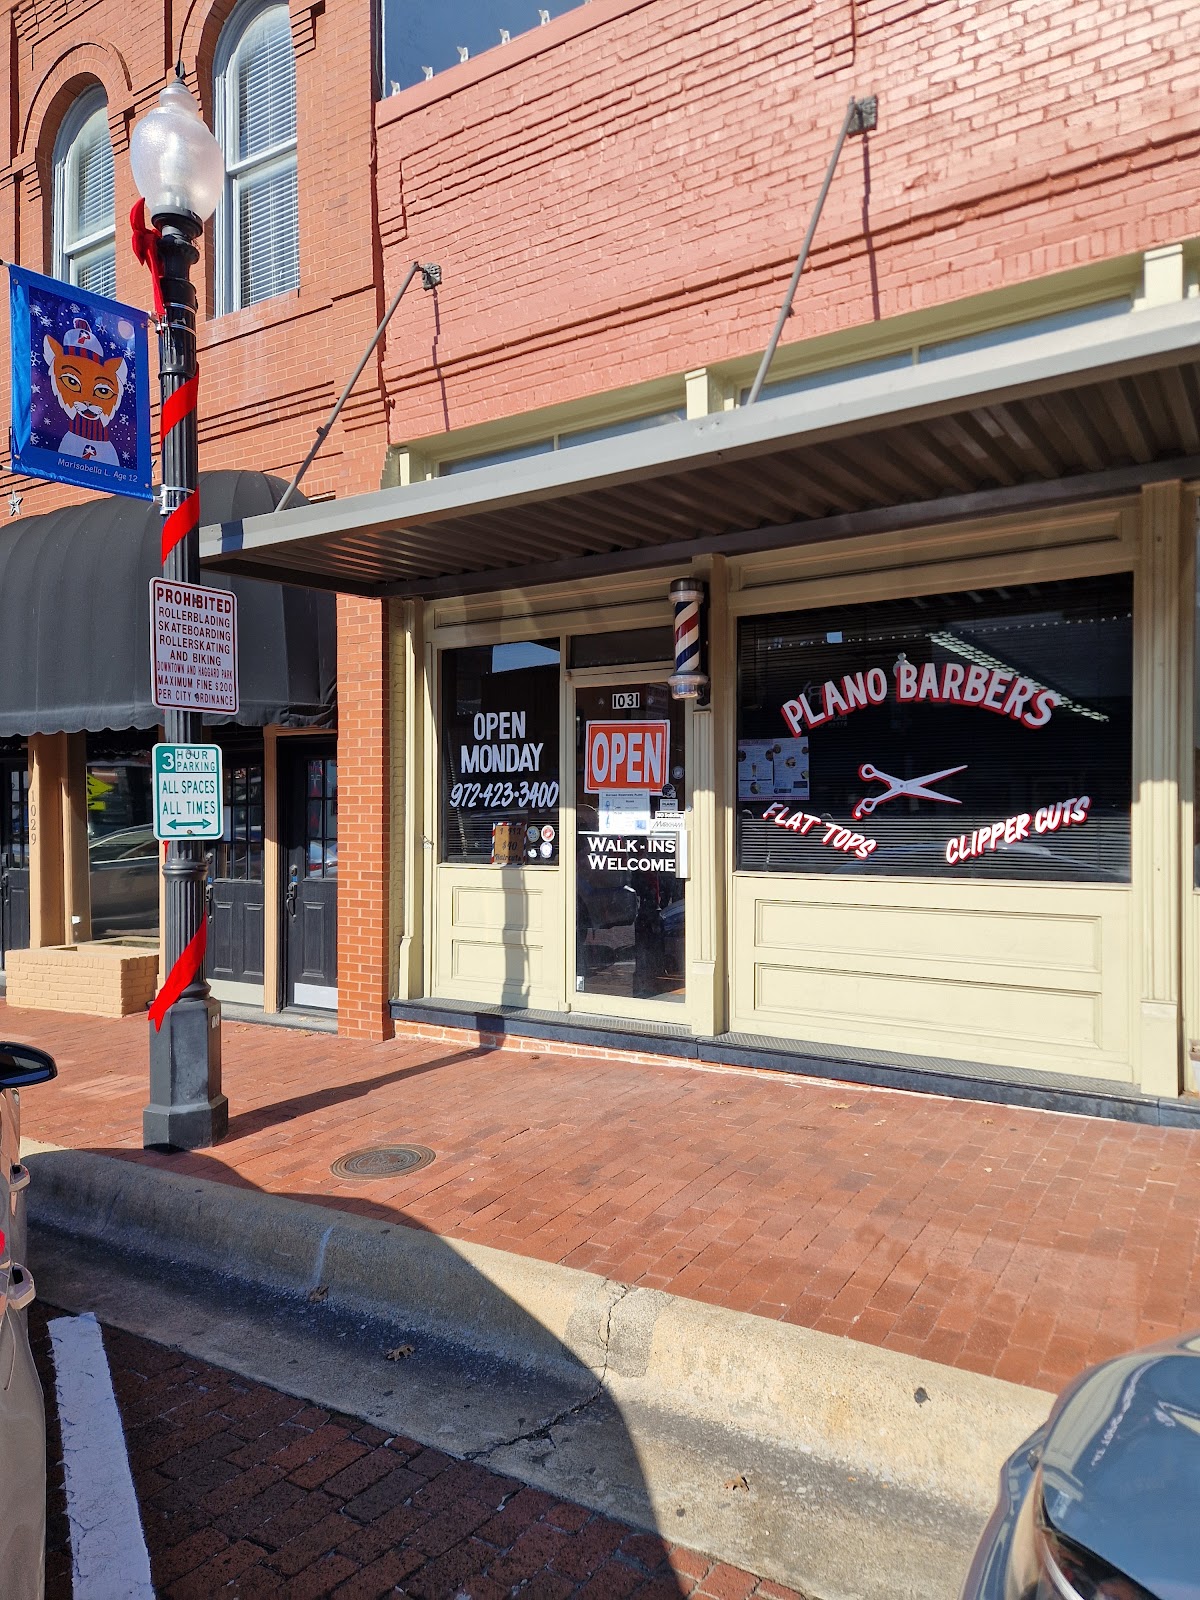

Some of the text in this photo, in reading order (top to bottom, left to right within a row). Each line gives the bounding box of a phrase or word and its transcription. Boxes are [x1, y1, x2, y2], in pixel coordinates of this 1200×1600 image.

[58, 458, 138, 483] Marisabella L. Age 12
[157, 586, 232, 614] PROHIBITED
[158, 607, 231, 628] ROLLERBLADING
[158, 621, 231, 642] SKATEBOARDING
[159, 635, 230, 655] ROLLERSKATING
[170, 650, 221, 666] AND BIKING
[157, 660, 233, 680] DOWNTOWN AND HAGGARD PARK
[158, 674, 233, 692] MAXIMUM FINE $200
[158, 688, 233, 706] PER CITY ORDINANCE
[613, 693, 639, 708] 1031
[780, 663, 1061, 739] PLANO BARBERS
[473, 711, 526, 741] OPEN
[161, 750, 208, 770] 3 HOUR
[177, 761, 216, 772] PARKING
[461, 743, 544, 773] MONDAY
[591, 732, 662, 783] OPEN
[162, 780, 215, 794] ALL SPACES
[162, 800, 216, 815] ALL TIMES
[763, 802, 878, 860] FLAT TOPS
[945, 796, 1093, 866] CLIPPER CUTS
[587, 854, 676, 872] WELCOME
